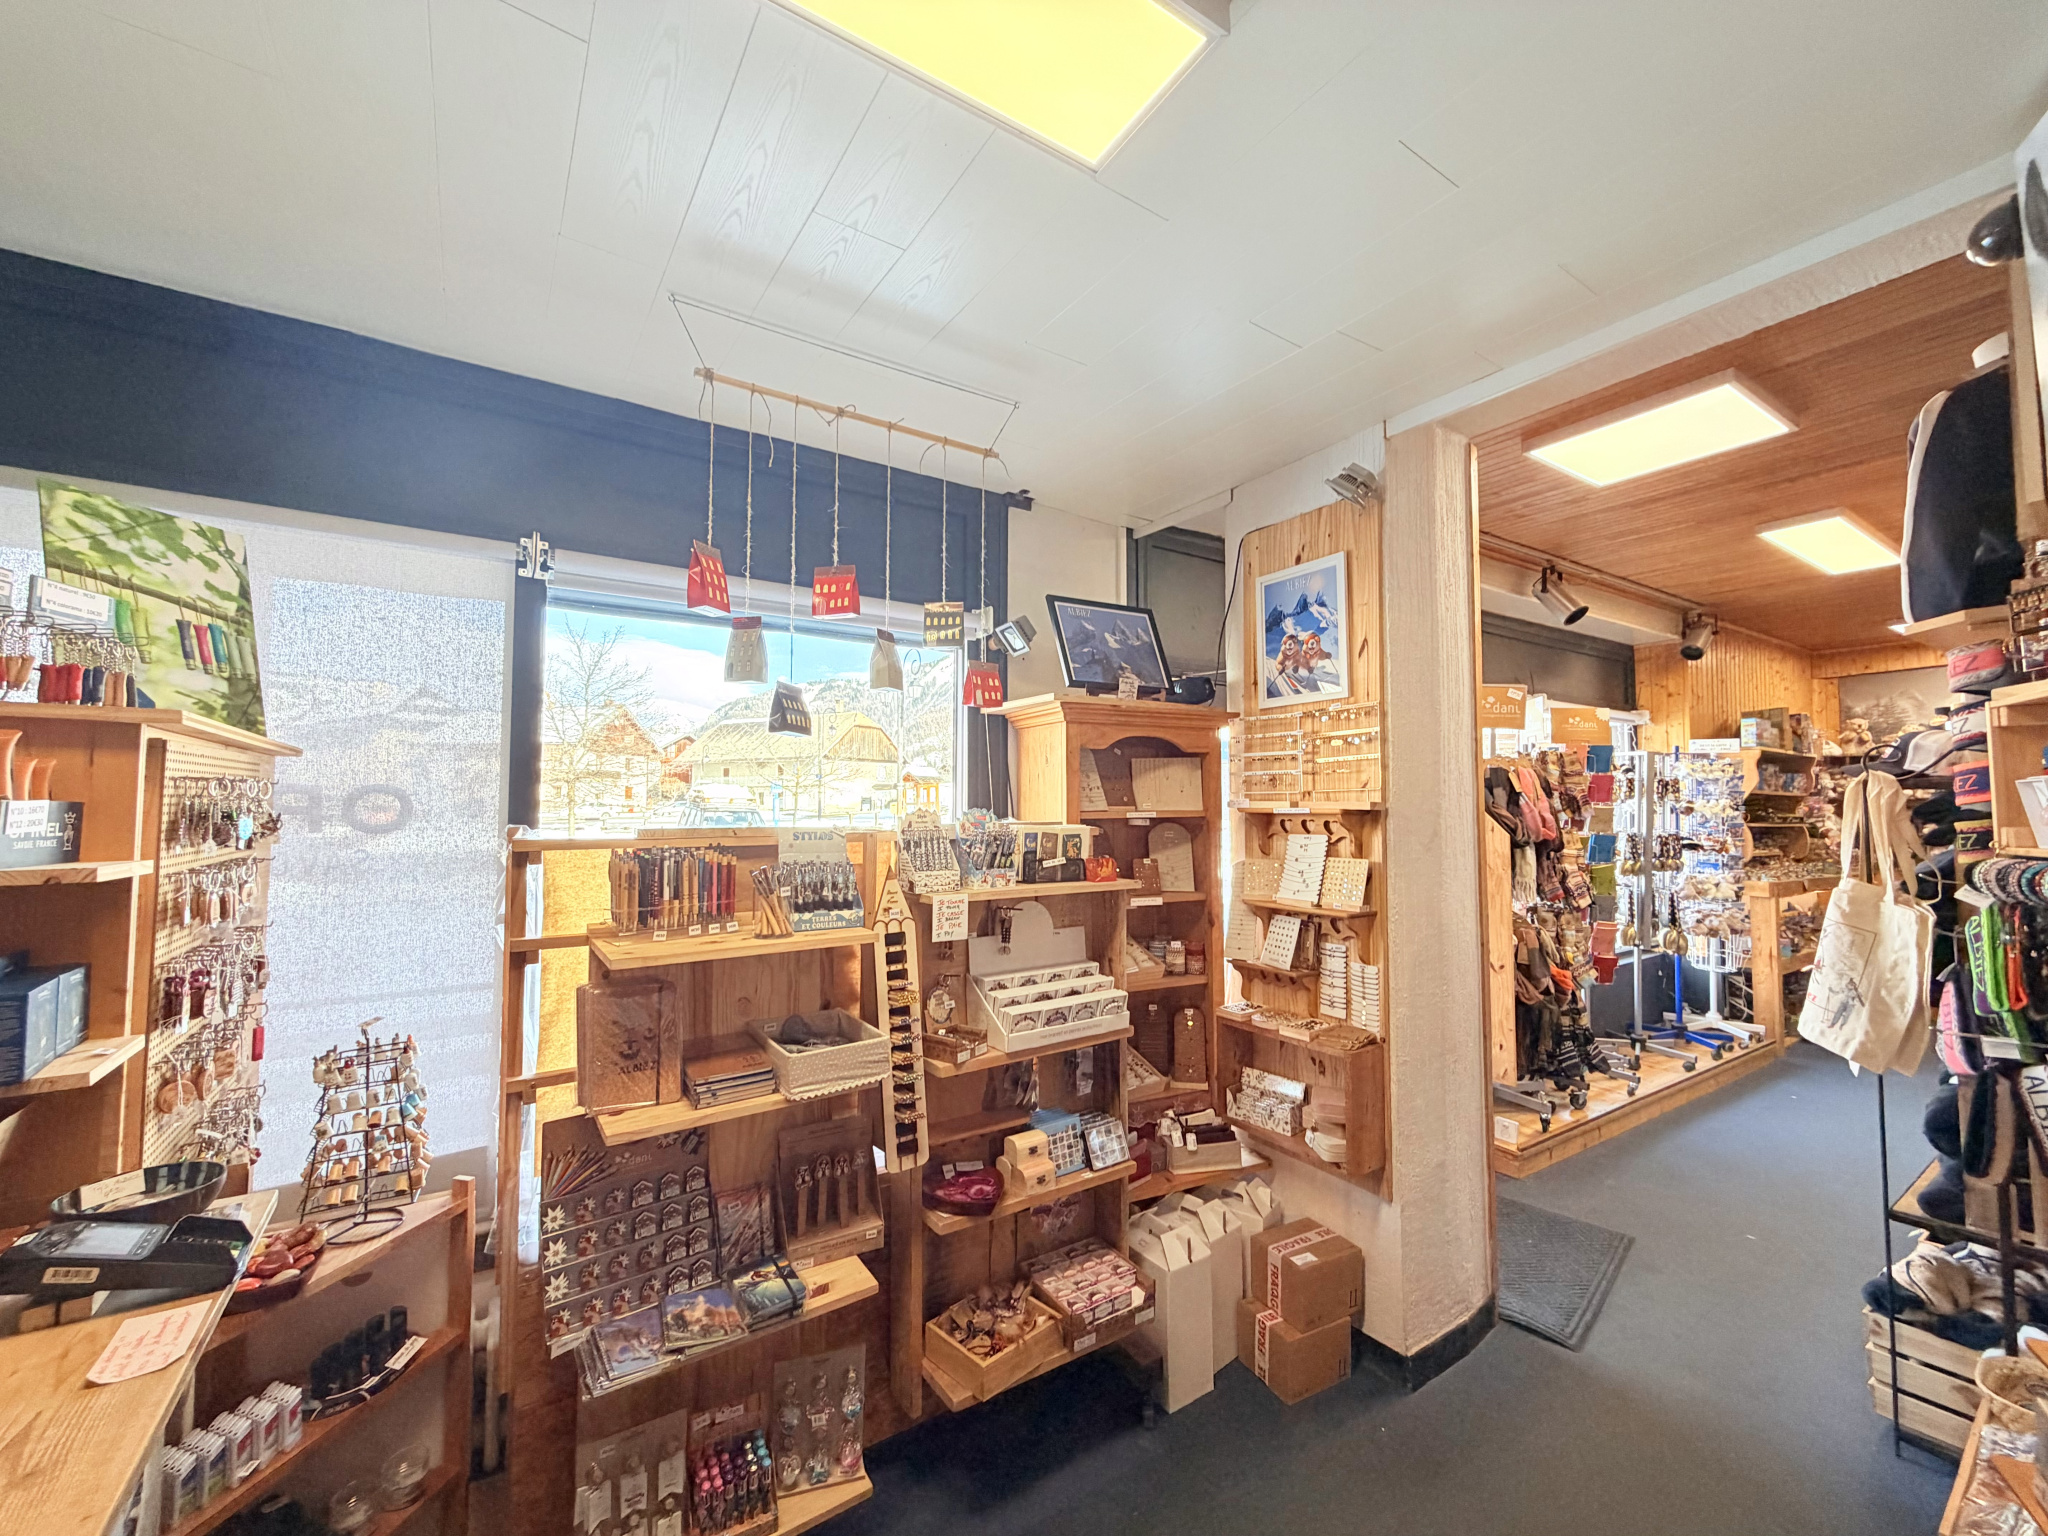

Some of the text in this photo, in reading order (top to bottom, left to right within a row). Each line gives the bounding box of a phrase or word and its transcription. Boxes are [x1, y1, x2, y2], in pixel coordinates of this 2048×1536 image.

[1286, 574, 1312, 592] ALBIEZ
[1067, 606, 1091, 618] ALBIEZ
[1493, 701, 1521, 714] dani
[1578, 721, 1598, 729] dani
[793, 831, 834, 841] STYLOS
[812, 915, 837, 923] TERRES
[811, 920, 846, 929] COULEURS
